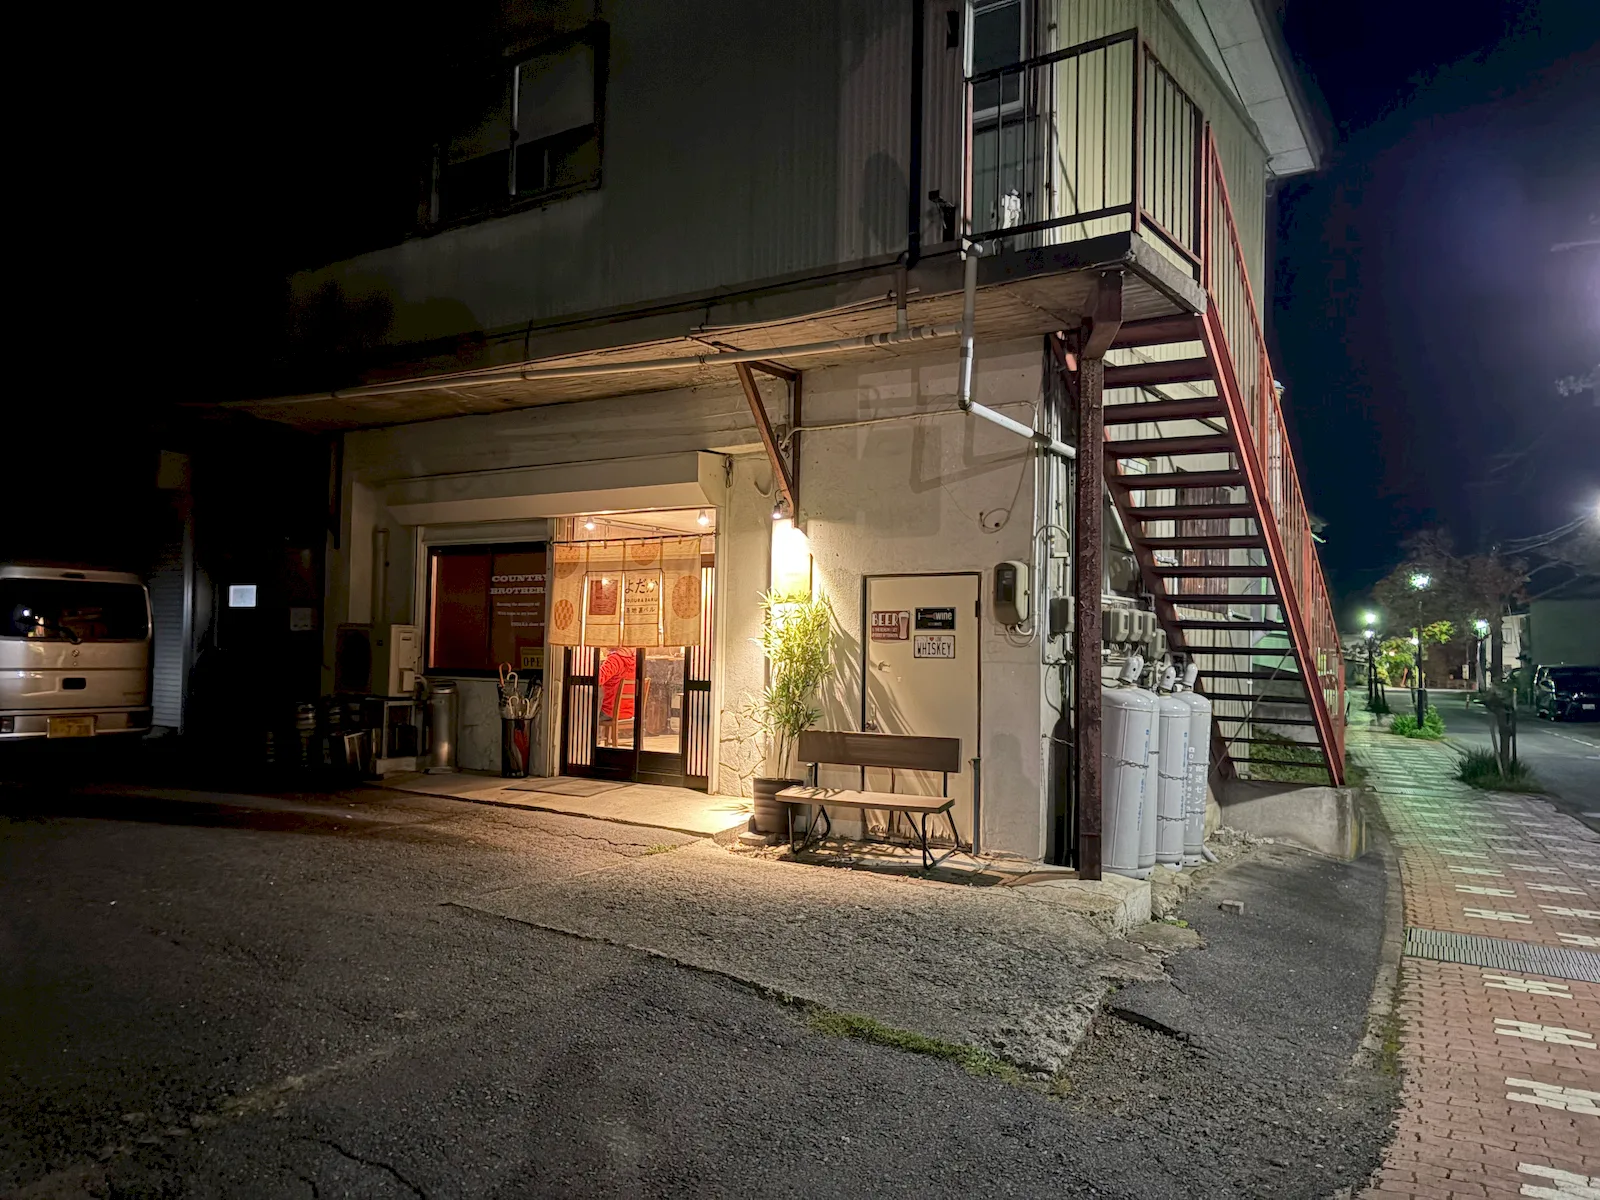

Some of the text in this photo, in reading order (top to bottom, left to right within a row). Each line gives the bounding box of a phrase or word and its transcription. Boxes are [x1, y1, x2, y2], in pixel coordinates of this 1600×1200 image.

[625, 578, 659, 594] よだか
[872, 613, 899, 626] BEER
[917, 642, 951, 655] WHISKEY
[523, 657, 543, 667] OPE
